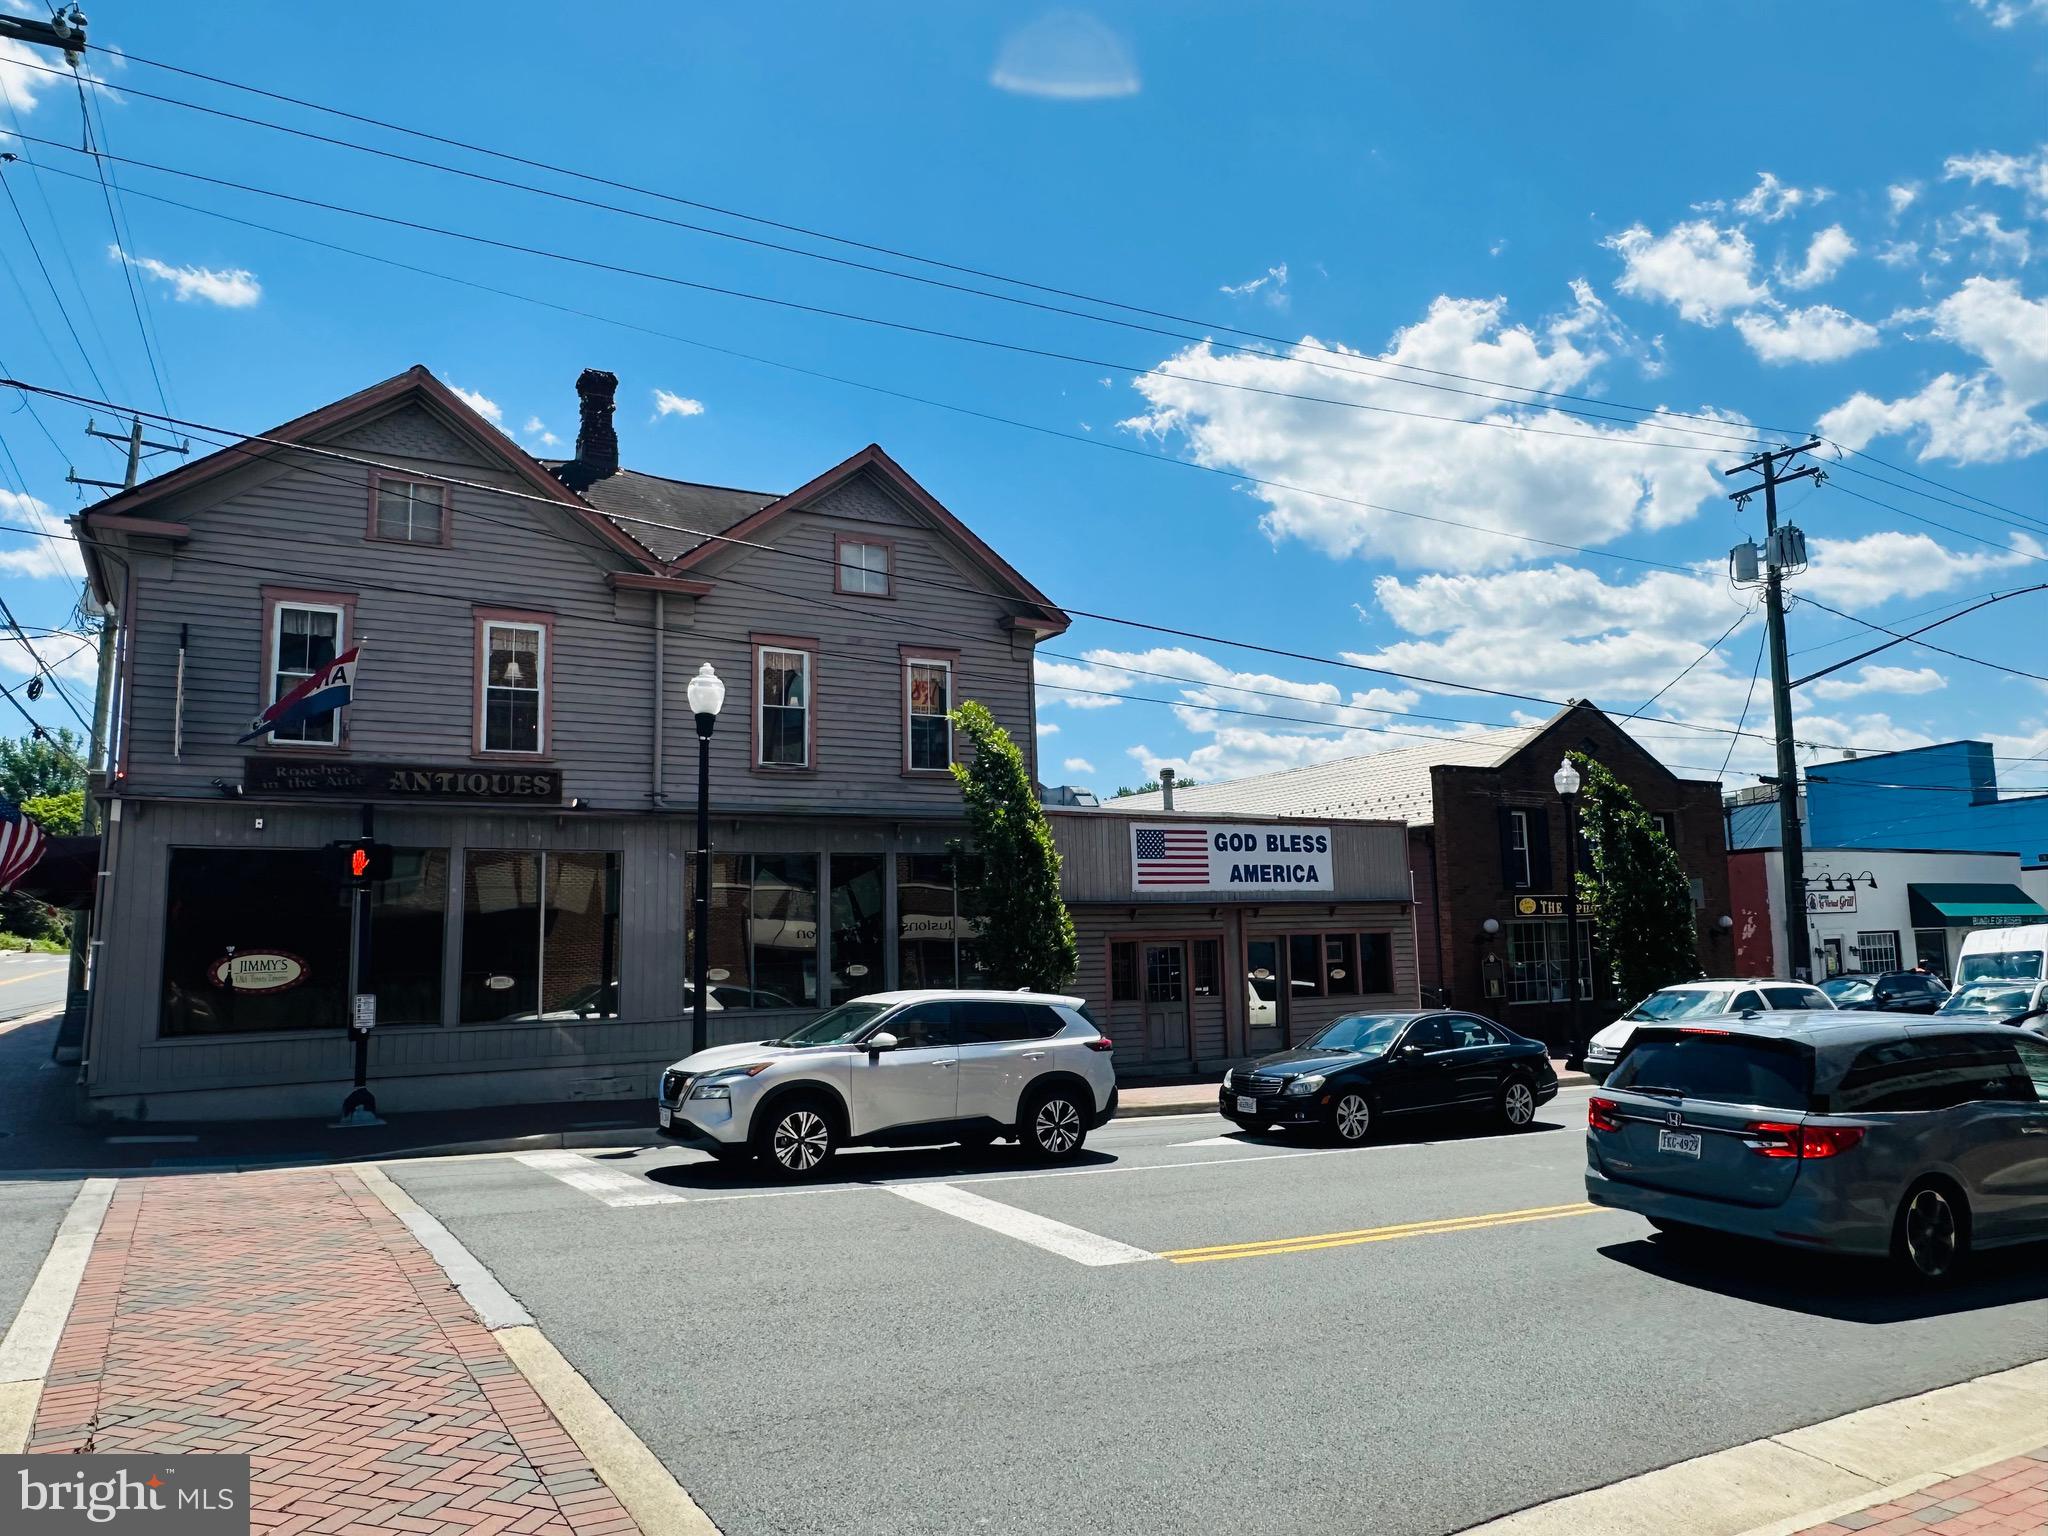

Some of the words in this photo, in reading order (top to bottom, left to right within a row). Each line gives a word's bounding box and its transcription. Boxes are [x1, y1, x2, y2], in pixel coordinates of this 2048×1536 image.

[276, 765, 352, 777] Roaches
[288, 777, 317, 788] the
[327, 774, 365, 787] Attic
[389, 770, 551, 797] ANTIQUES
[1214, 833, 1258, 852] GOD
[1266, 834, 1327, 853] BLESS
[1229, 864, 1319, 883] AMERICA
[1540, 900, 1563, 914] THE
[240, 959, 288, 973] JIMMY'S
